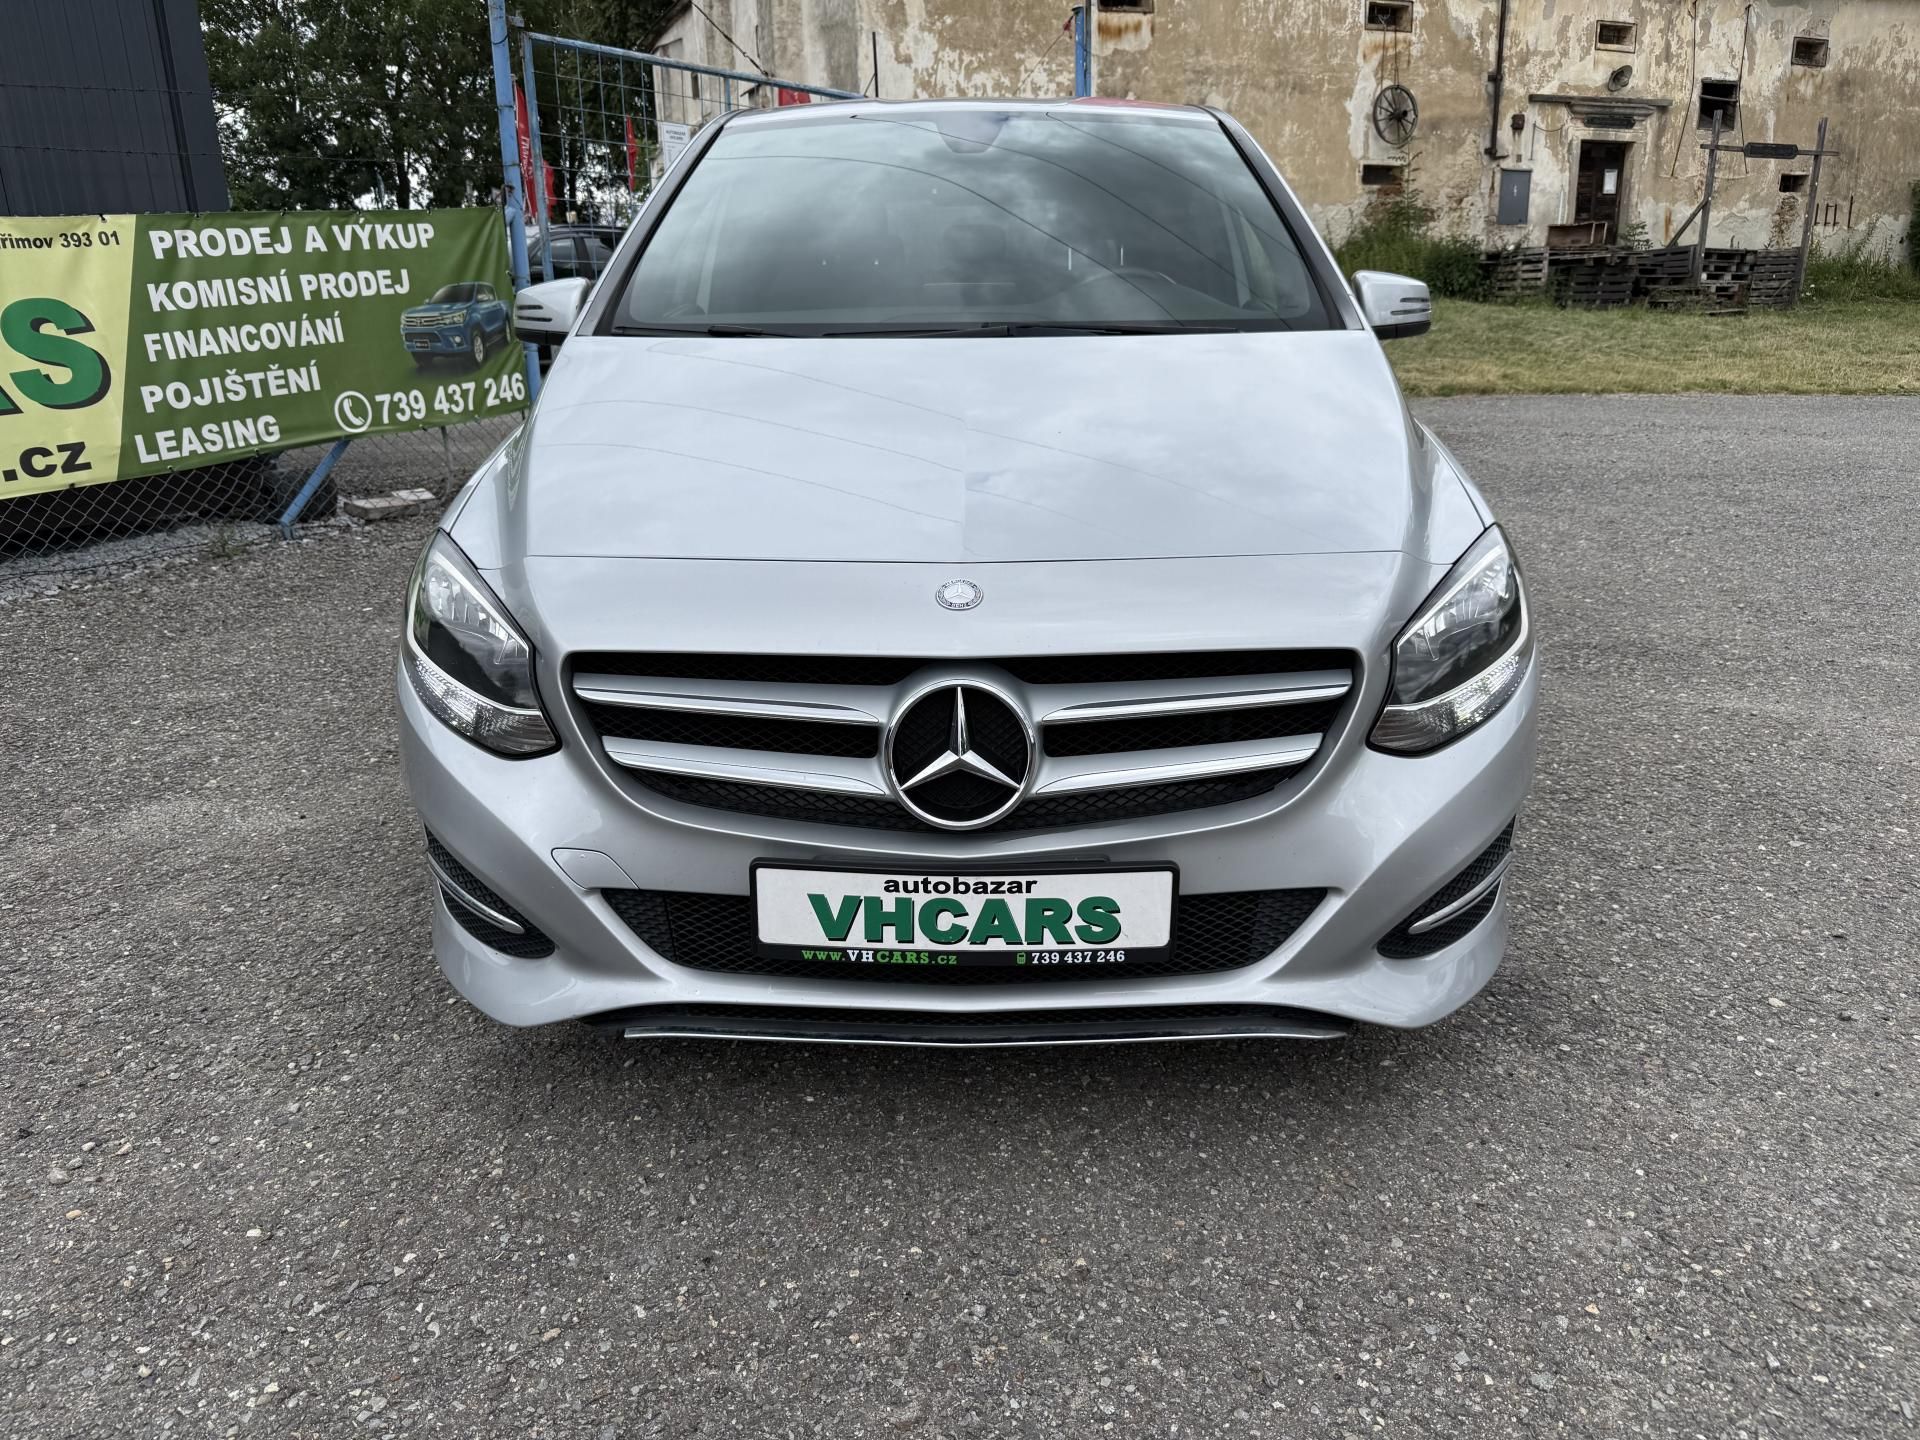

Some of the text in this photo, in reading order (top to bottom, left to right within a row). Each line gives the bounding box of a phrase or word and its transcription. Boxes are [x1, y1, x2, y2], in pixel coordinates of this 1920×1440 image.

[0, 230, 120, 249] řimov 393 01
[149, 217, 435, 259] PRODEJ A VÝKUP
[147, 268, 410, 312] KOMISNÍ PRODEJ
[143, 310, 345, 362] FINANCOVÁNÍ
[140, 359, 321, 413] POJIŠTĚNÍ
[375, 372, 526, 424] 739 437 246
[134, 414, 281, 464] LEASING
[883, 877, 1038, 895] autobazar
[806, 892, 1122, 945] VHCARS
[1031, 950, 1126, 964] 739 437 246
